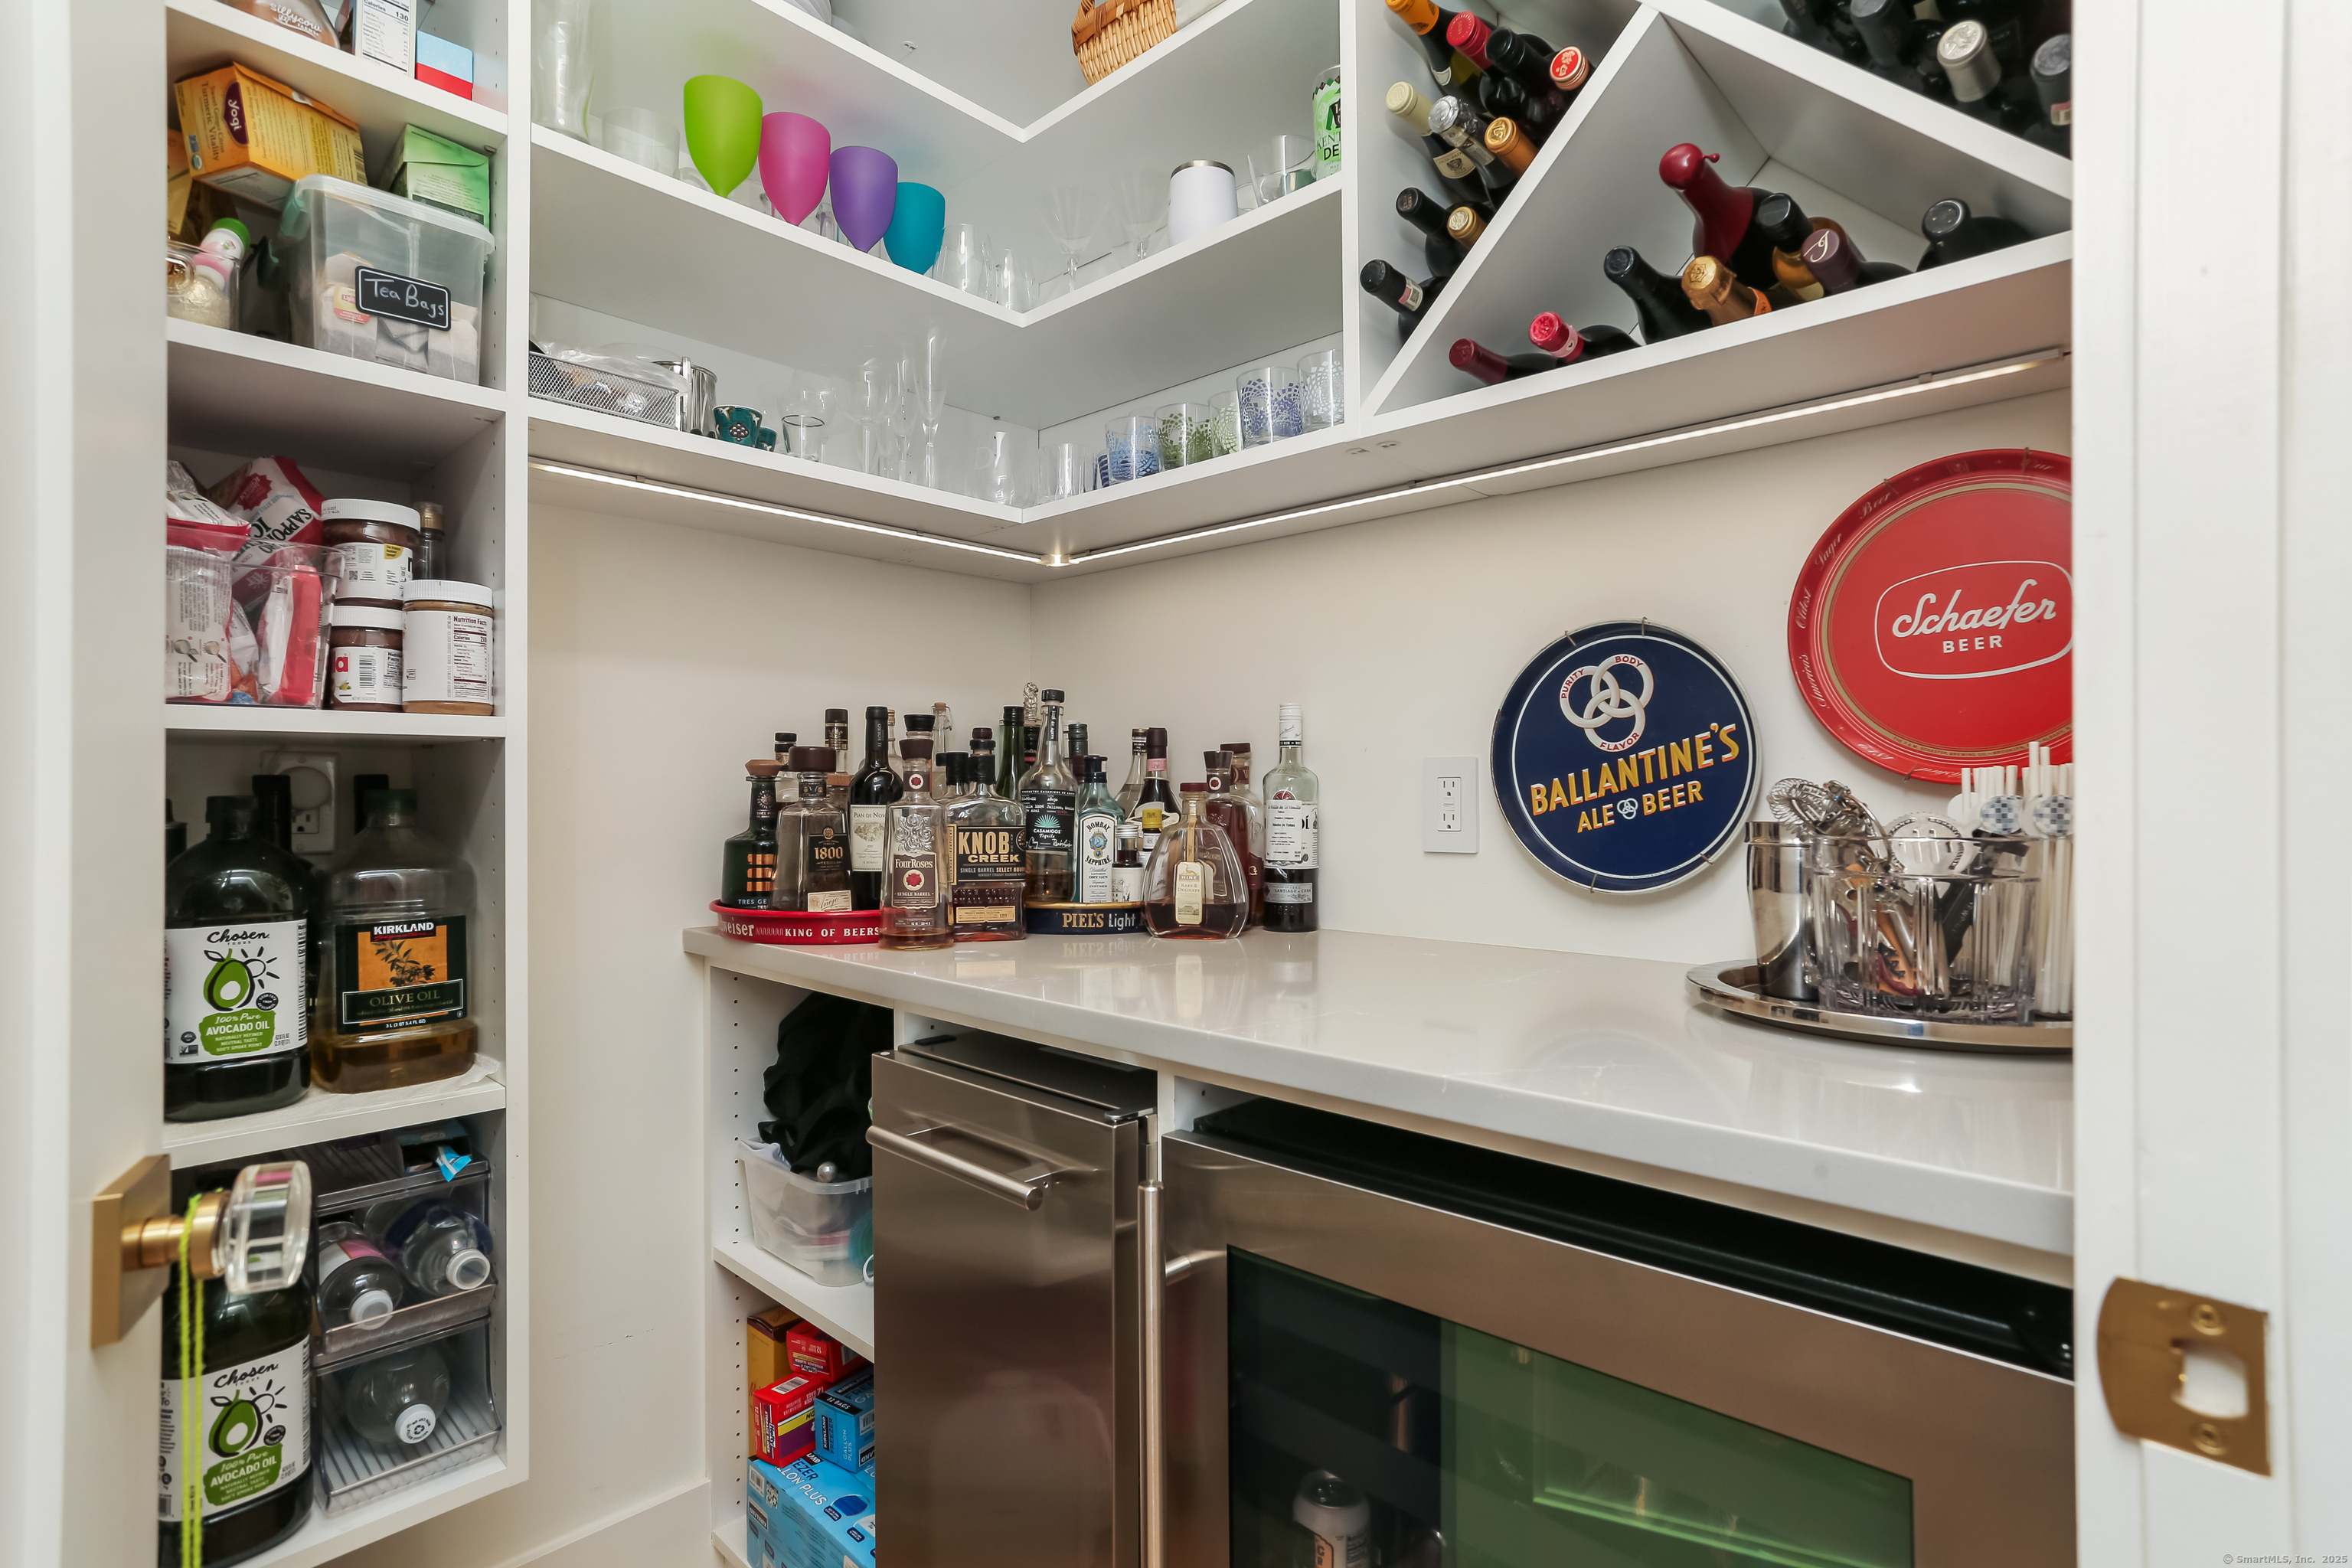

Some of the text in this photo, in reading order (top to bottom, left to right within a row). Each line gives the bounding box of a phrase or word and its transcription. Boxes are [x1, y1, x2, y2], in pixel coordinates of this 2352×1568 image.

[396, 11, 409, 21] 130
[201, 81, 219, 162] Turmeric Vitality
[228, 100, 242, 131] yogi
[1316, 132, 1341, 152] KENT
[364, 279, 445, 318] Tea Bags
[1815, 533, 1843, 571] Lager
[1859, 492, 1892, 520] Beer
[1892, 579, 2056, 638] Schaefer
[454, 616, 476, 625] Nutrition
[1942, 634, 2004, 654] BEER
[1615, 655, 1644, 668] BODY
[1561, 668, 1586, 699] PURITY
[1599, 732, 1640, 751] FLAVOR
[1530, 722, 1740, 816] BALLANTINE'S
[1577, 780, 1704, 834] ALE BEER
[1086, 822, 1111, 832] BOMBAY
[959, 831, 1010, 854] KNOB
[814, 847, 844, 860] 1800
[968, 854, 1020, 863] CREEK
[1085, 855, 1112, 866] SAPPHIRE
[820, 897, 841, 911] Añejo
[374, 922, 434, 935] KIRKLAND
[719, 915, 754, 936] dweiser
[1062, 913, 1135, 930] PIEL'S Light
[207, 929, 270, 943] Chosen
[785, 927, 879, 937] KING OF BEERS
[370, 990, 440, 1007] OLIVE OIL
[206, 1021, 270, 1036] AVOCADO OIL
[215, 1015, 239, 1024] 100%
[214, 1363, 279, 1388] Chosen
[802, 1364, 817, 1374] Hefty
[837, 1374, 871, 1393] KIRKLAND
[844, 1380, 873, 1400] FREE
[834, 1400, 851, 1410] BAGS
[211, 1455, 277, 1487] AVOCADO OIL
[220, 1451, 268, 1473] 100% Pure
[792, 1458, 818, 1481] EZER
[799, 1483, 828, 1505] PLUS
